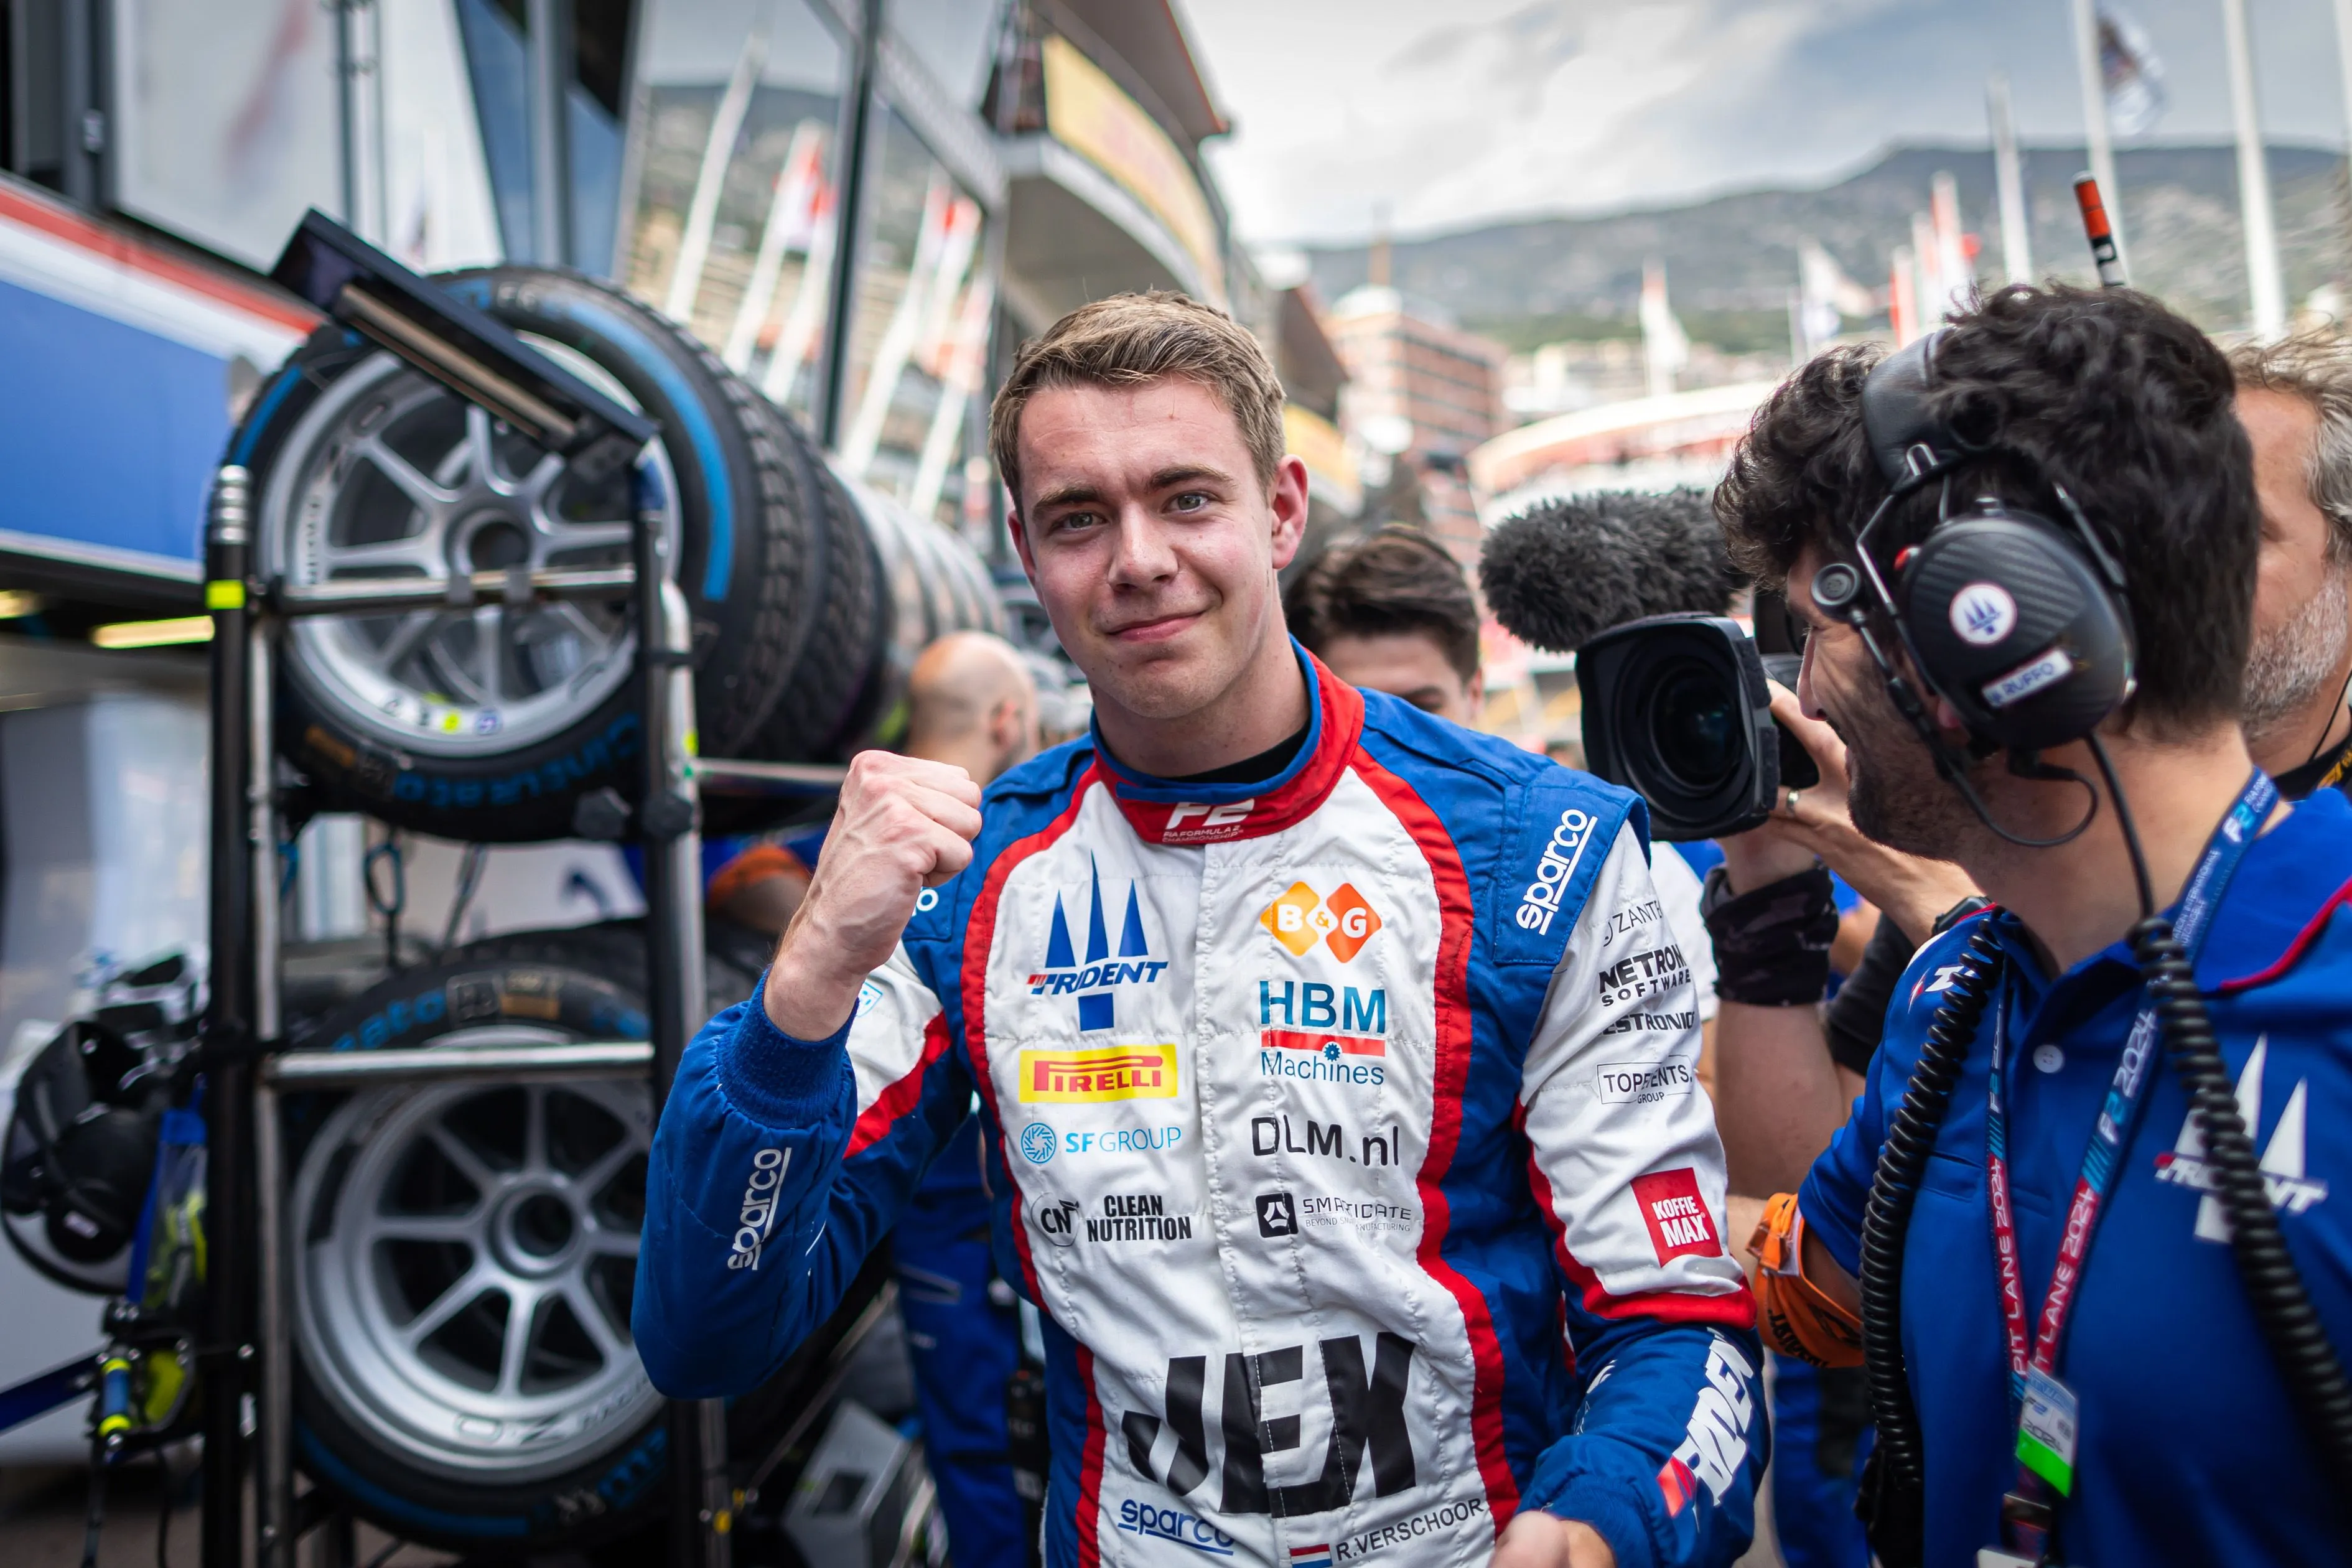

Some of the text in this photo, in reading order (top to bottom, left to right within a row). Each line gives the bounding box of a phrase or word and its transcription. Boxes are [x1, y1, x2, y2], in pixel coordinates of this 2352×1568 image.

[1179, 828, 1231, 837] FORMULA
[2221, 802, 2256, 842] F2
[1516, 809, 1598, 935] sparco
[1277, 904, 1367, 938] B&G
[1027, 961, 1169, 995] TRIDENT
[1602, 968, 1691, 1007] SOFTWARE
[1259, 981, 1386, 1034] HBM
[1034, 1055, 1163, 1093] PIRELLI
[1261, 1052, 1384, 1086] Machines
[2098, 1010, 2157, 1145] F2 2024
[1637, 1091, 1664, 1104] GROUP
[1251, 1114, 1399, 1167] DLM.nl
[728, 1147, 792, 1270] sparco
[1040, 1205, 1073, 1234] CN
[1104, 1195, 1164, 1218] CLEAN
[1306, 1218, 1337, 1227] BEYOND
[1651, 1196, 1699, 1220] KOFFIE
[1086, 1216, 1192, 1243] NUTRITION
[1659, 1214, 1710, 1248] MAX
[1991, 1158, 2027, 1376] PIT LANE 2024
[2040, 1261, 2073, 1342] LANE
[2061, 1188, 2096, 1258] 2024
[1121, 1332, 1416, 1519] JEX
[1336, 1497, 1485, 1562] R.VERSCHOOR
